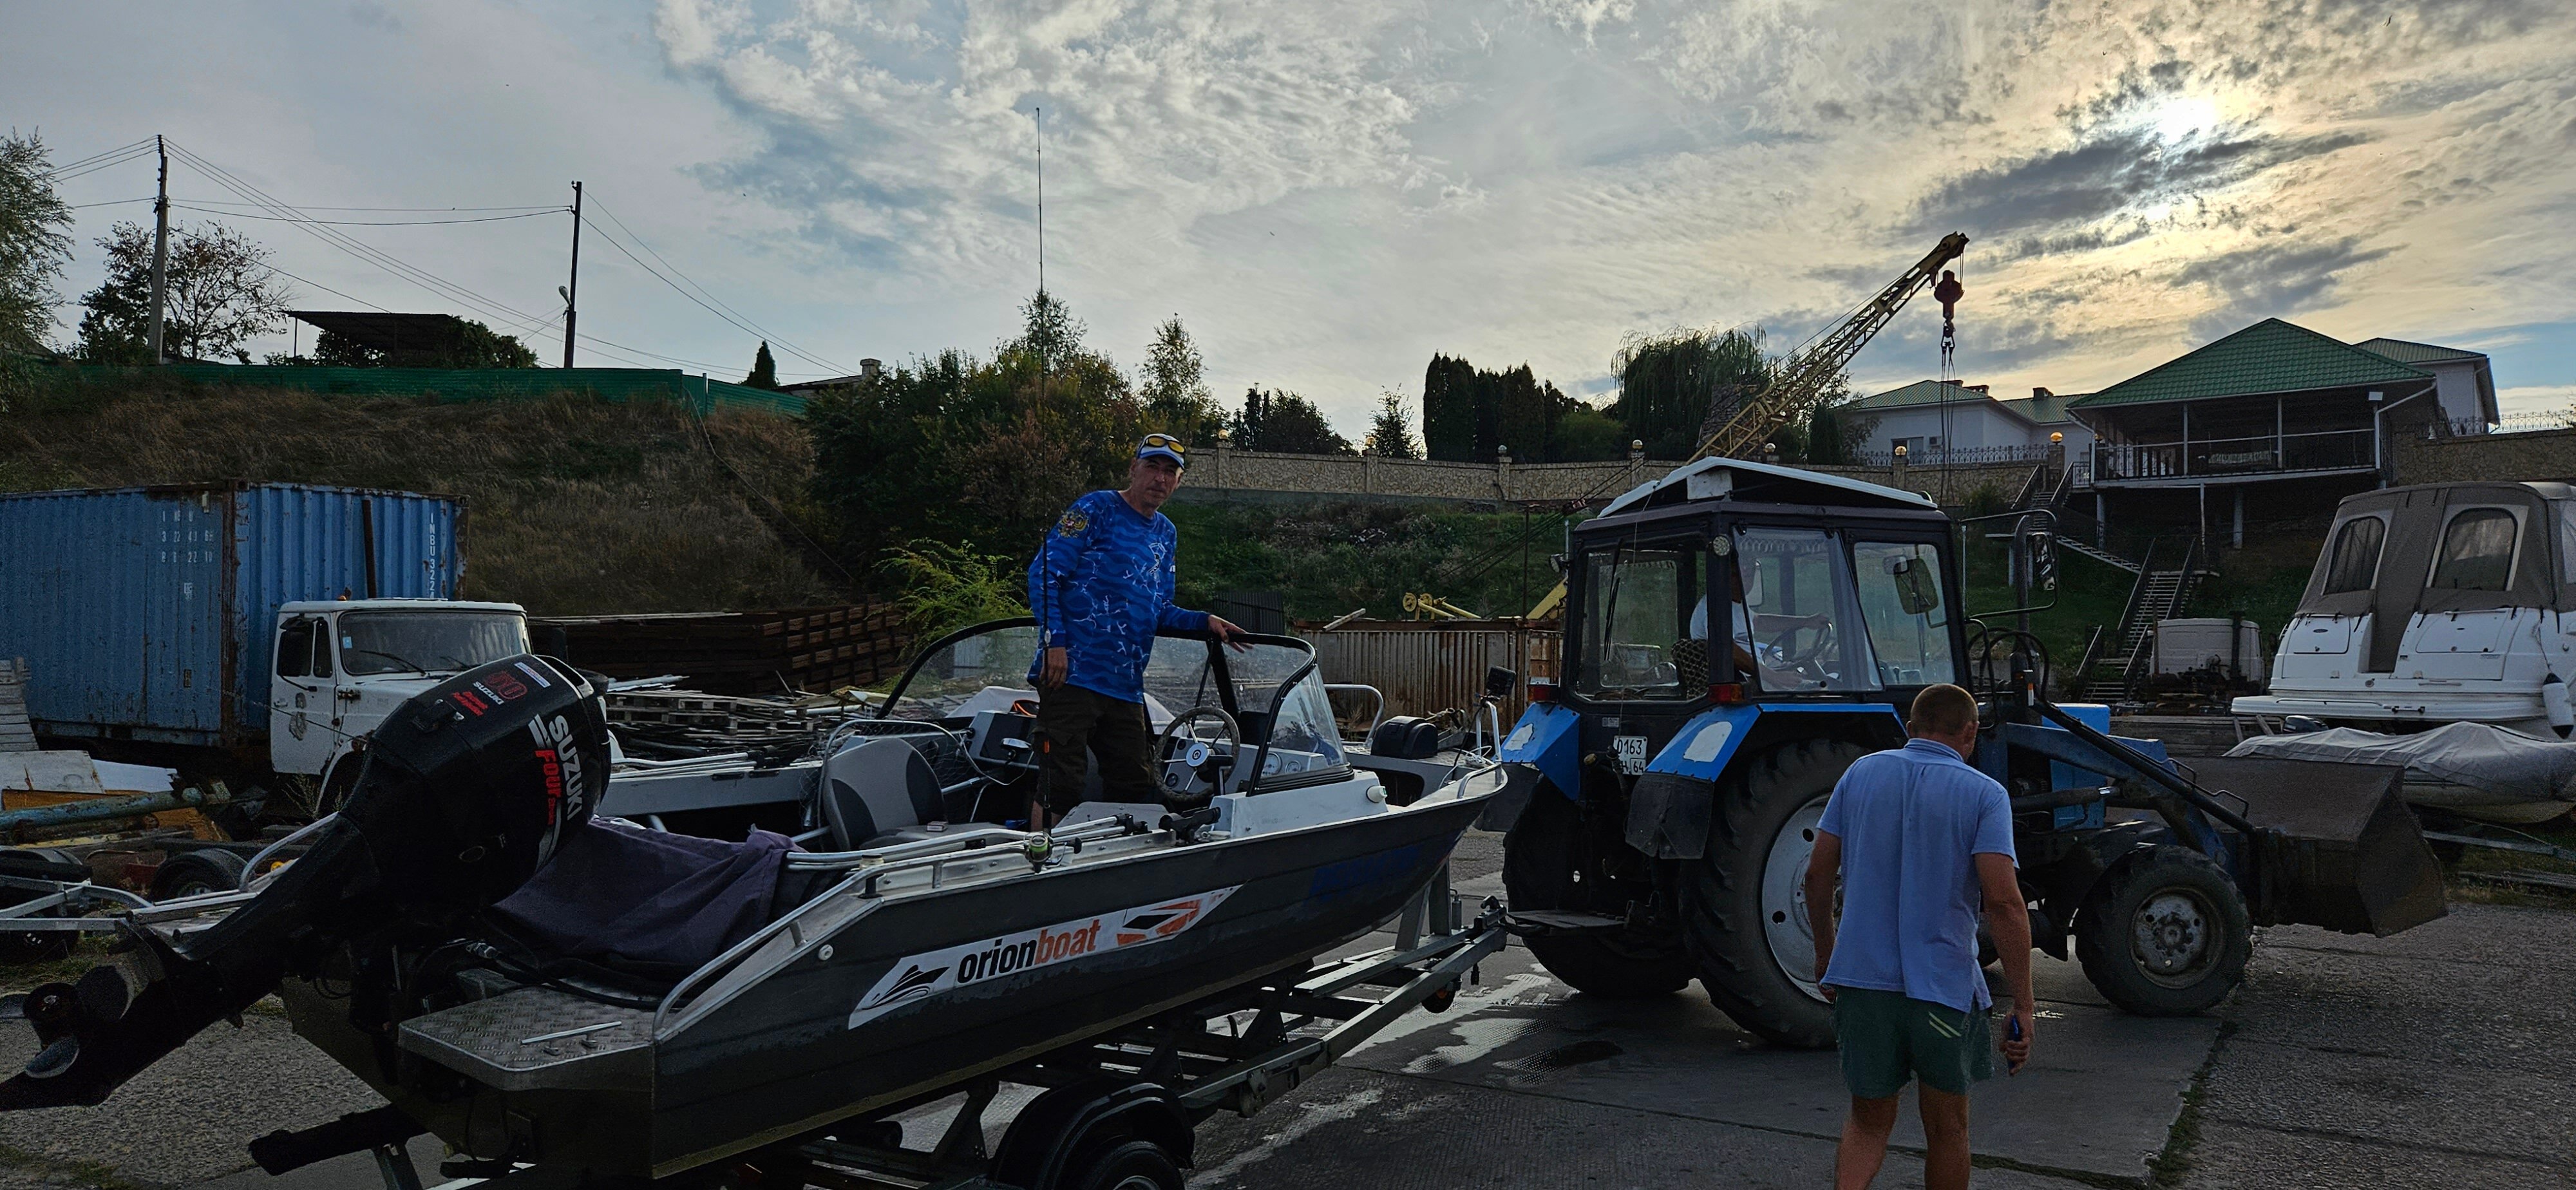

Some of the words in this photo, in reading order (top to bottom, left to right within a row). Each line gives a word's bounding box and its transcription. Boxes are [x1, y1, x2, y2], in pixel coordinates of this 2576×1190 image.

[473, 681, 505, 705] SUZUKI
[549, 715, 582, 821] SUZUKI
[1633, 761, 1643, 773] 64
[957, 919, 1101, 984] orionboat
